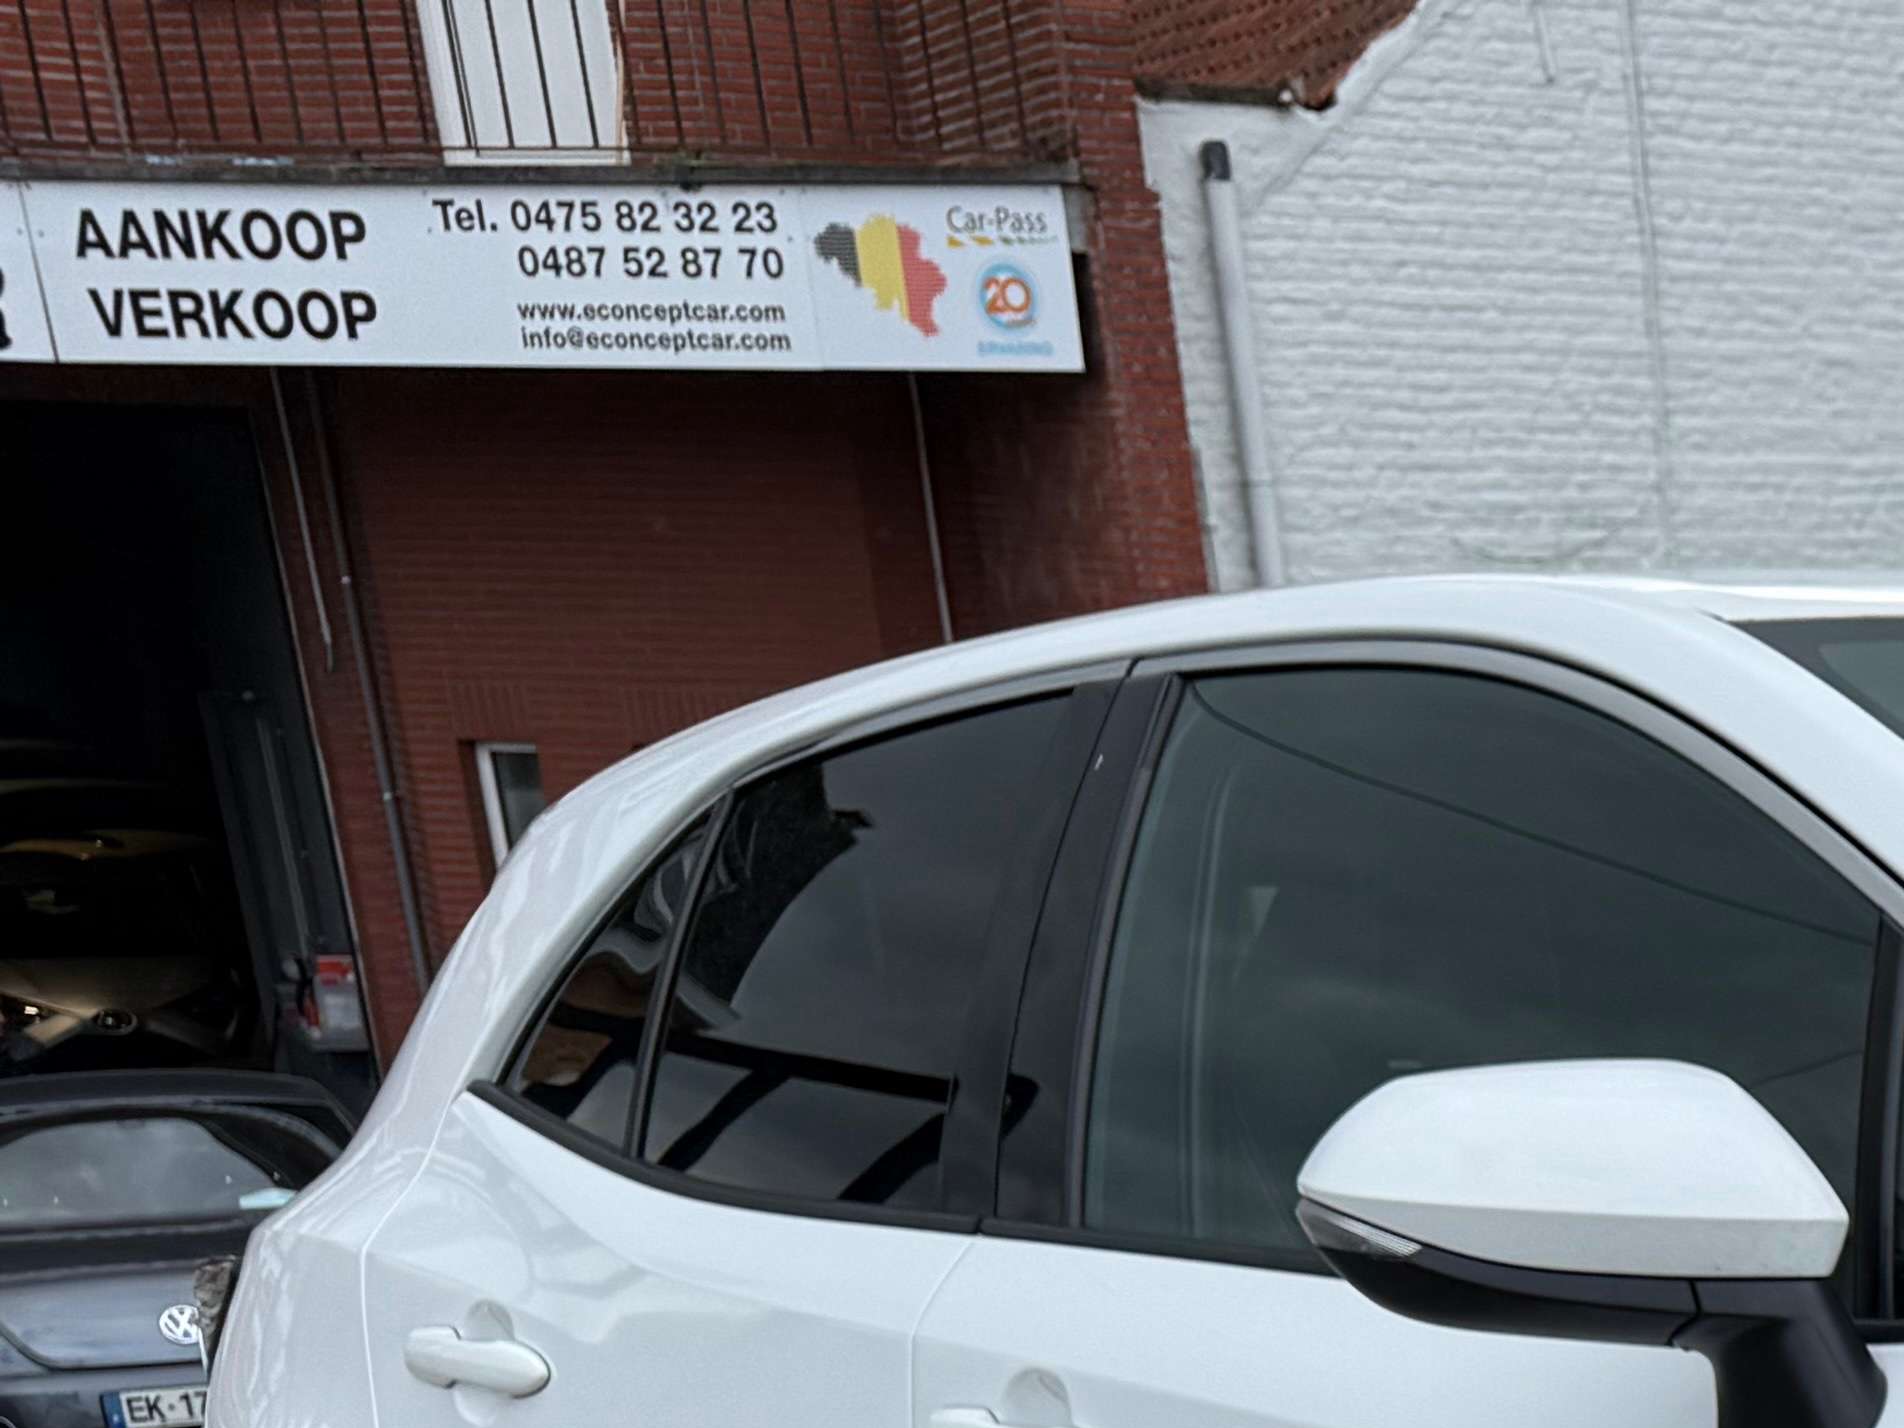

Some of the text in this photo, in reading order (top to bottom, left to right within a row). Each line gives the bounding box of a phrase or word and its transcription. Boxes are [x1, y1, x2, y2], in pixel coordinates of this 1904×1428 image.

[432, 199, 777, 234] Tel. 0475 82 32 23
[946, 206, 1048, 233] Car-Pass
[76, 208, 366, 261] AANKOOP
[518, 246, 784, 280] 0487 52 87 70
[517, 299, 786, 326] www.econceptcar.com
[983, 277, 1032, 314] 20
[88, 287, 377, 341] VERKOOP
[521, 326, 791, 354] info@econceptcar.com
